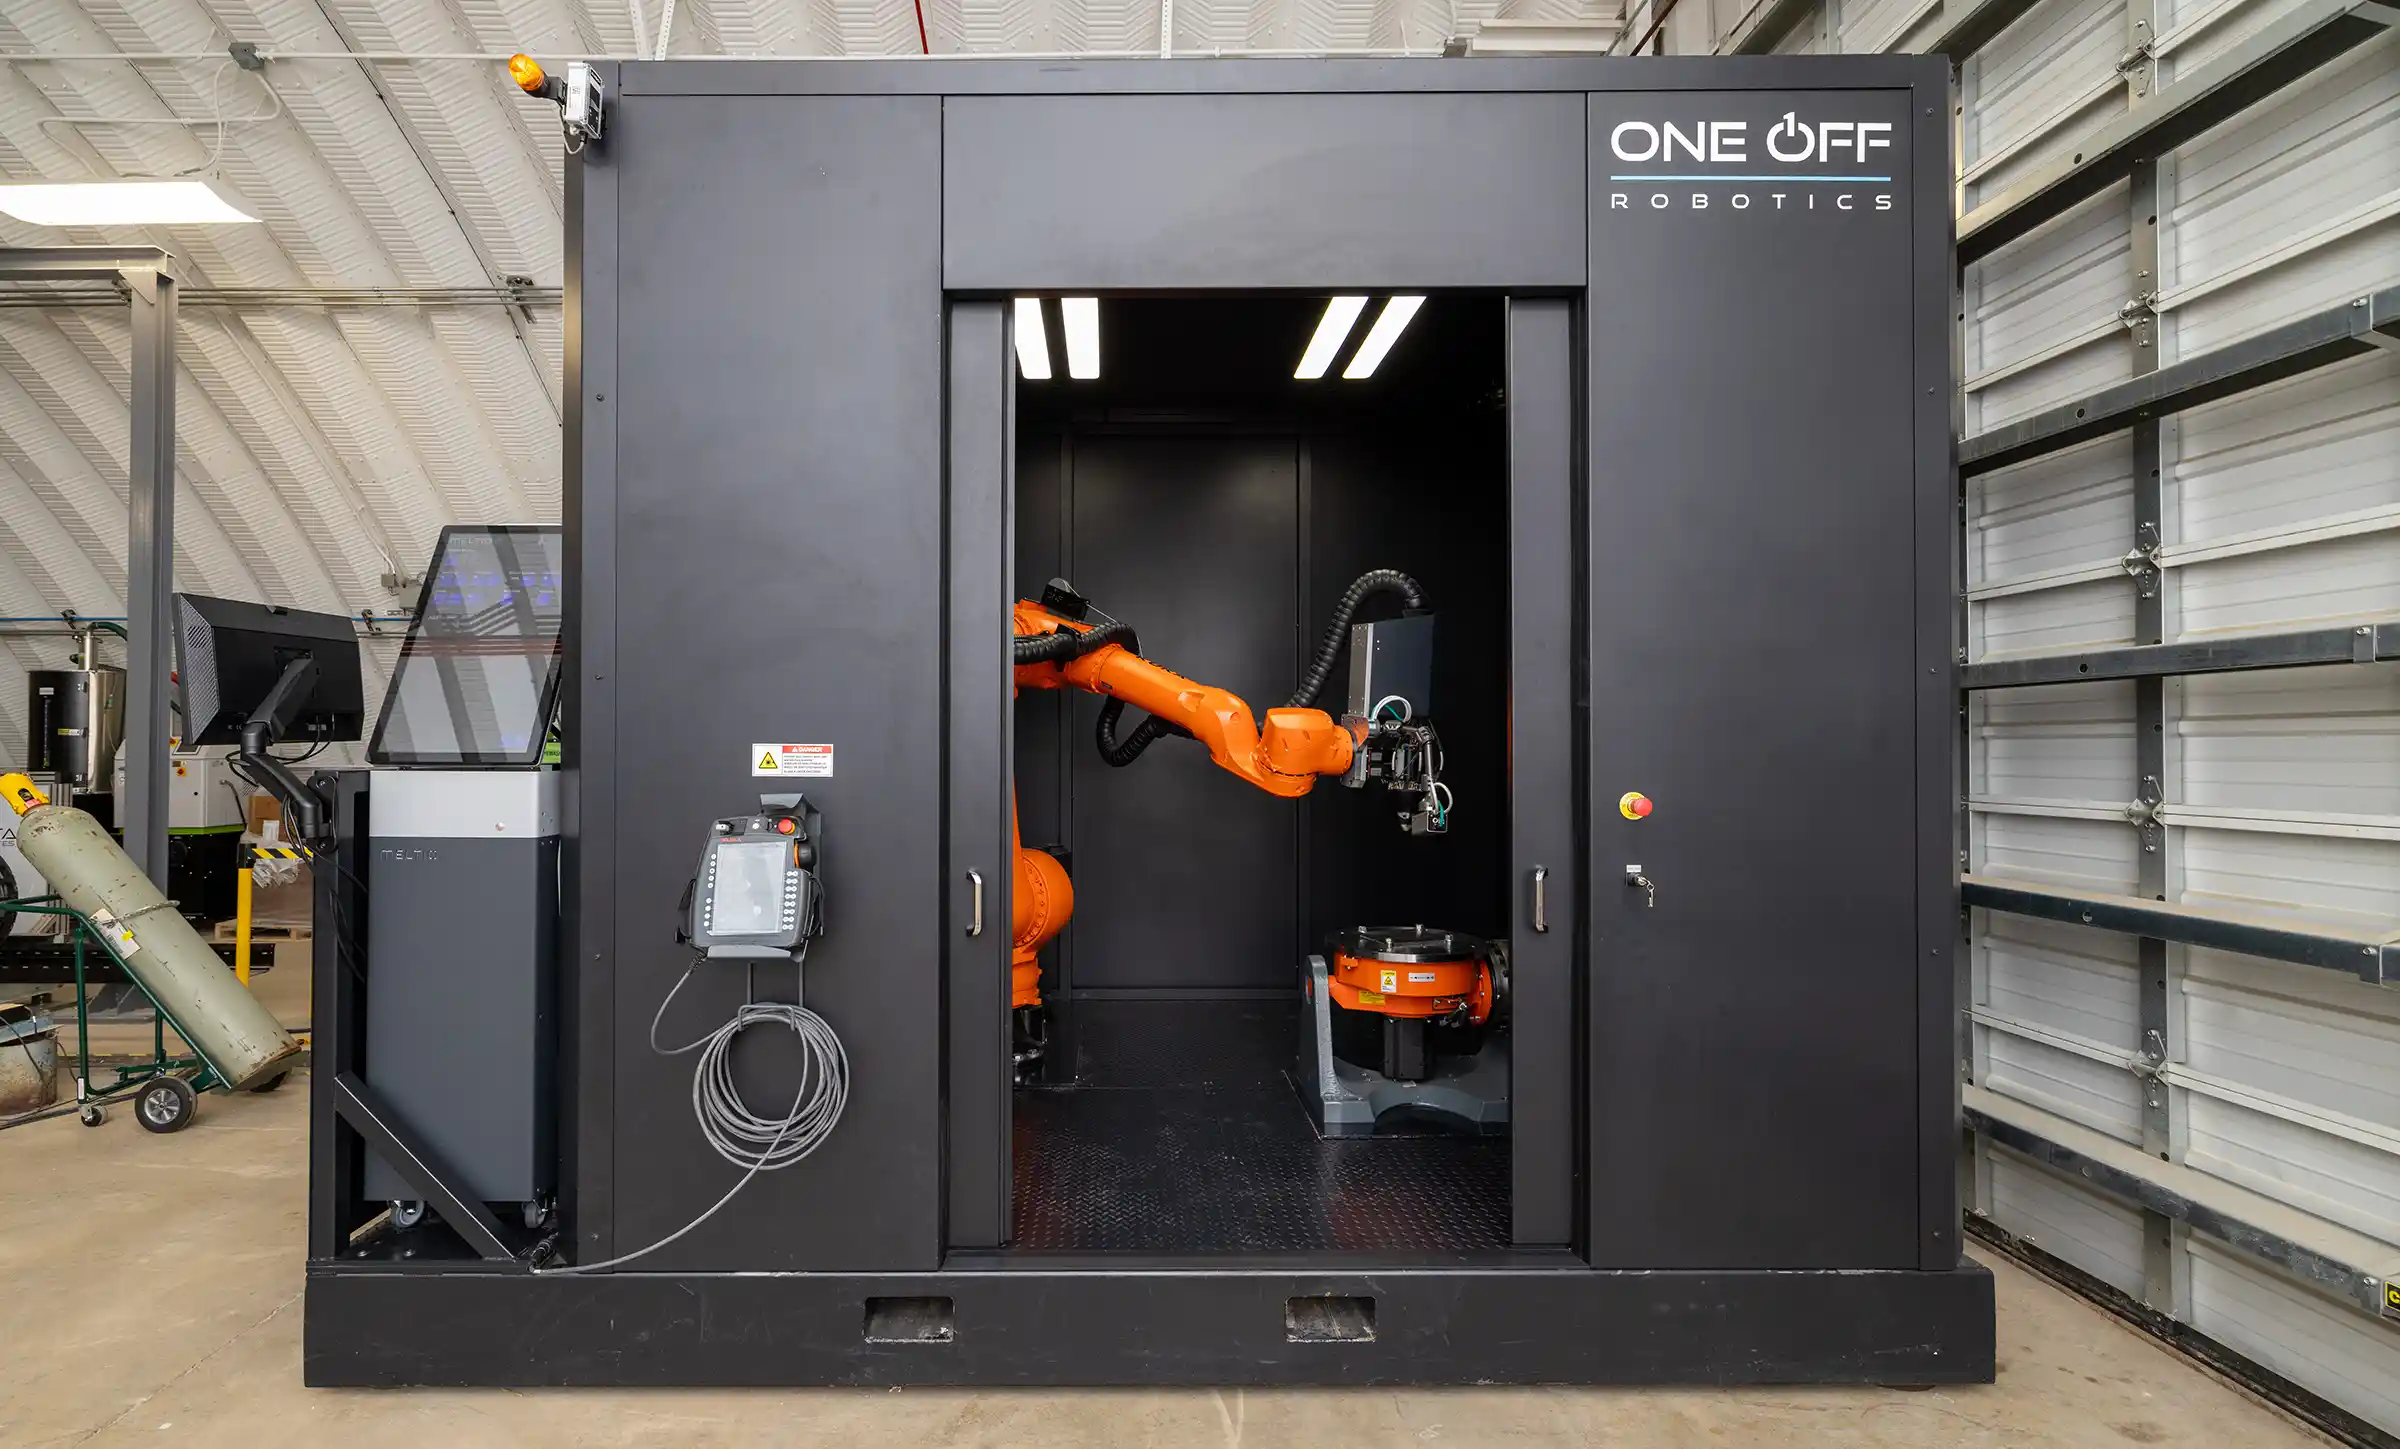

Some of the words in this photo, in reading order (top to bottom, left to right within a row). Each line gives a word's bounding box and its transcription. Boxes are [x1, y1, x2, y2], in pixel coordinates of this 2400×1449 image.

[1610, 121, 1747, 163] ONE
[1766, 111, 1892, 163] OFF
[1611, 193, 1892, 211] ROBOTICS
